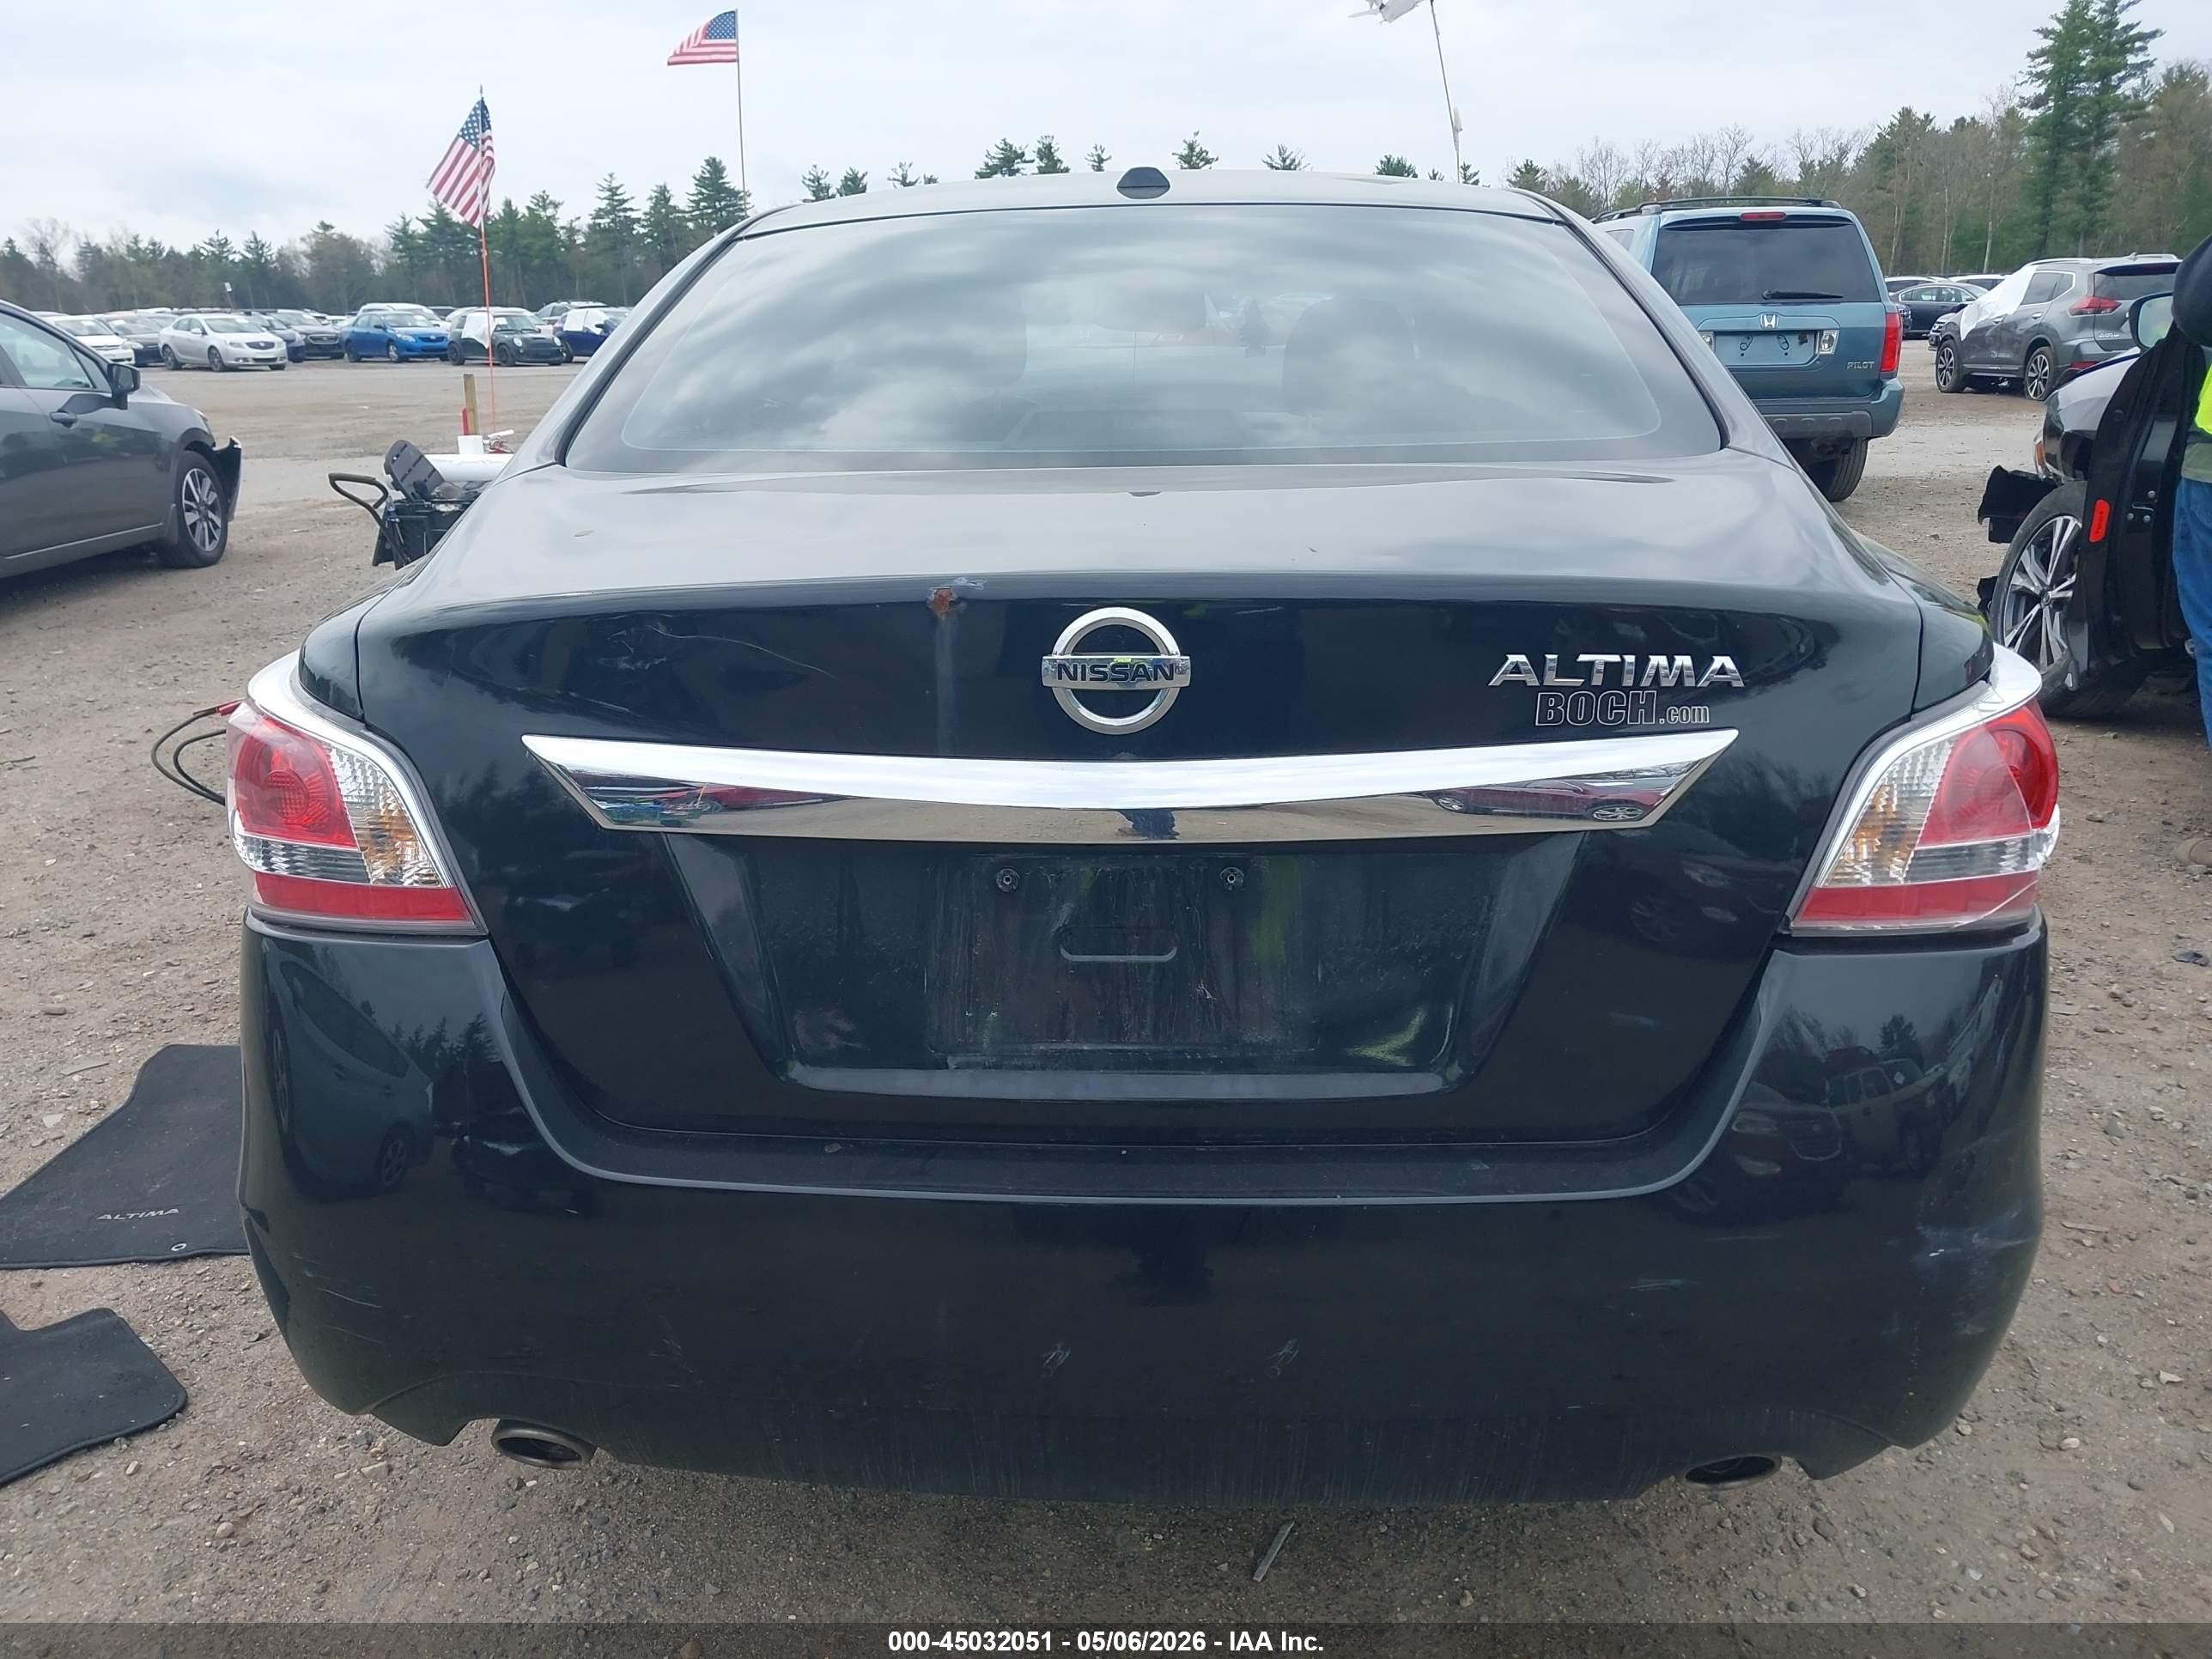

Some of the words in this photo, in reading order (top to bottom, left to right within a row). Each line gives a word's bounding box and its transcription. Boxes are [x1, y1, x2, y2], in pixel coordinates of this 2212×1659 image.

[1847, 361, 1875, 370] PILOT
[1056, 663, 1175, 682] NISSAN
[1488, 653, 1745, 687] ALTIMA
[1535, 690, 1710, 726] BOCH.com
[96, 1208, 179, 1220] ALTIMA
